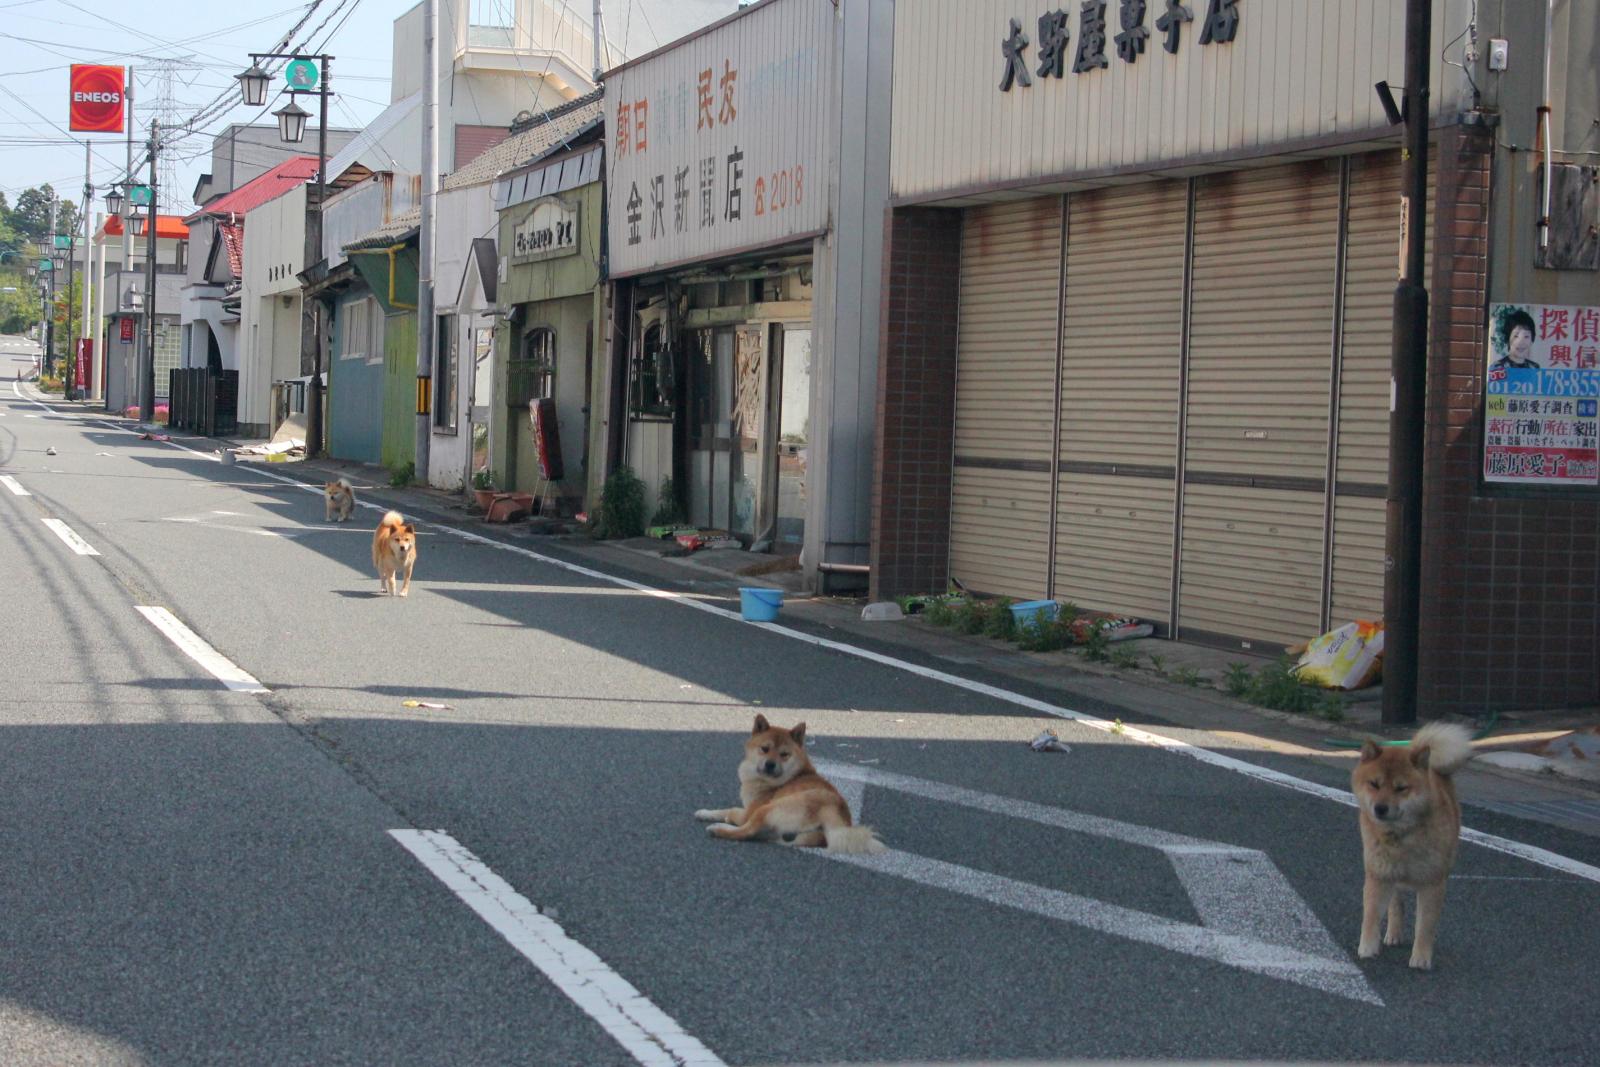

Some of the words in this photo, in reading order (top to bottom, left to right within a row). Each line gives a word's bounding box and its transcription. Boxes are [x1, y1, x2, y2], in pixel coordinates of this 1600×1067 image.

[74, 92, 120, 103] ENEOS
[616, 96, 649, 160] 朝日
[697, 58, 738, 133] 民友
[626, 145, 744, 246] 金沢新聞店
[770, 165, 804, 210] 2018
[1539, 307, 1600, 342] 探偵
[1549, 345, 1598, 368] 興信
[1488, 380, 1534, 394] 0120
[1488, 398, 1505, 410] web
